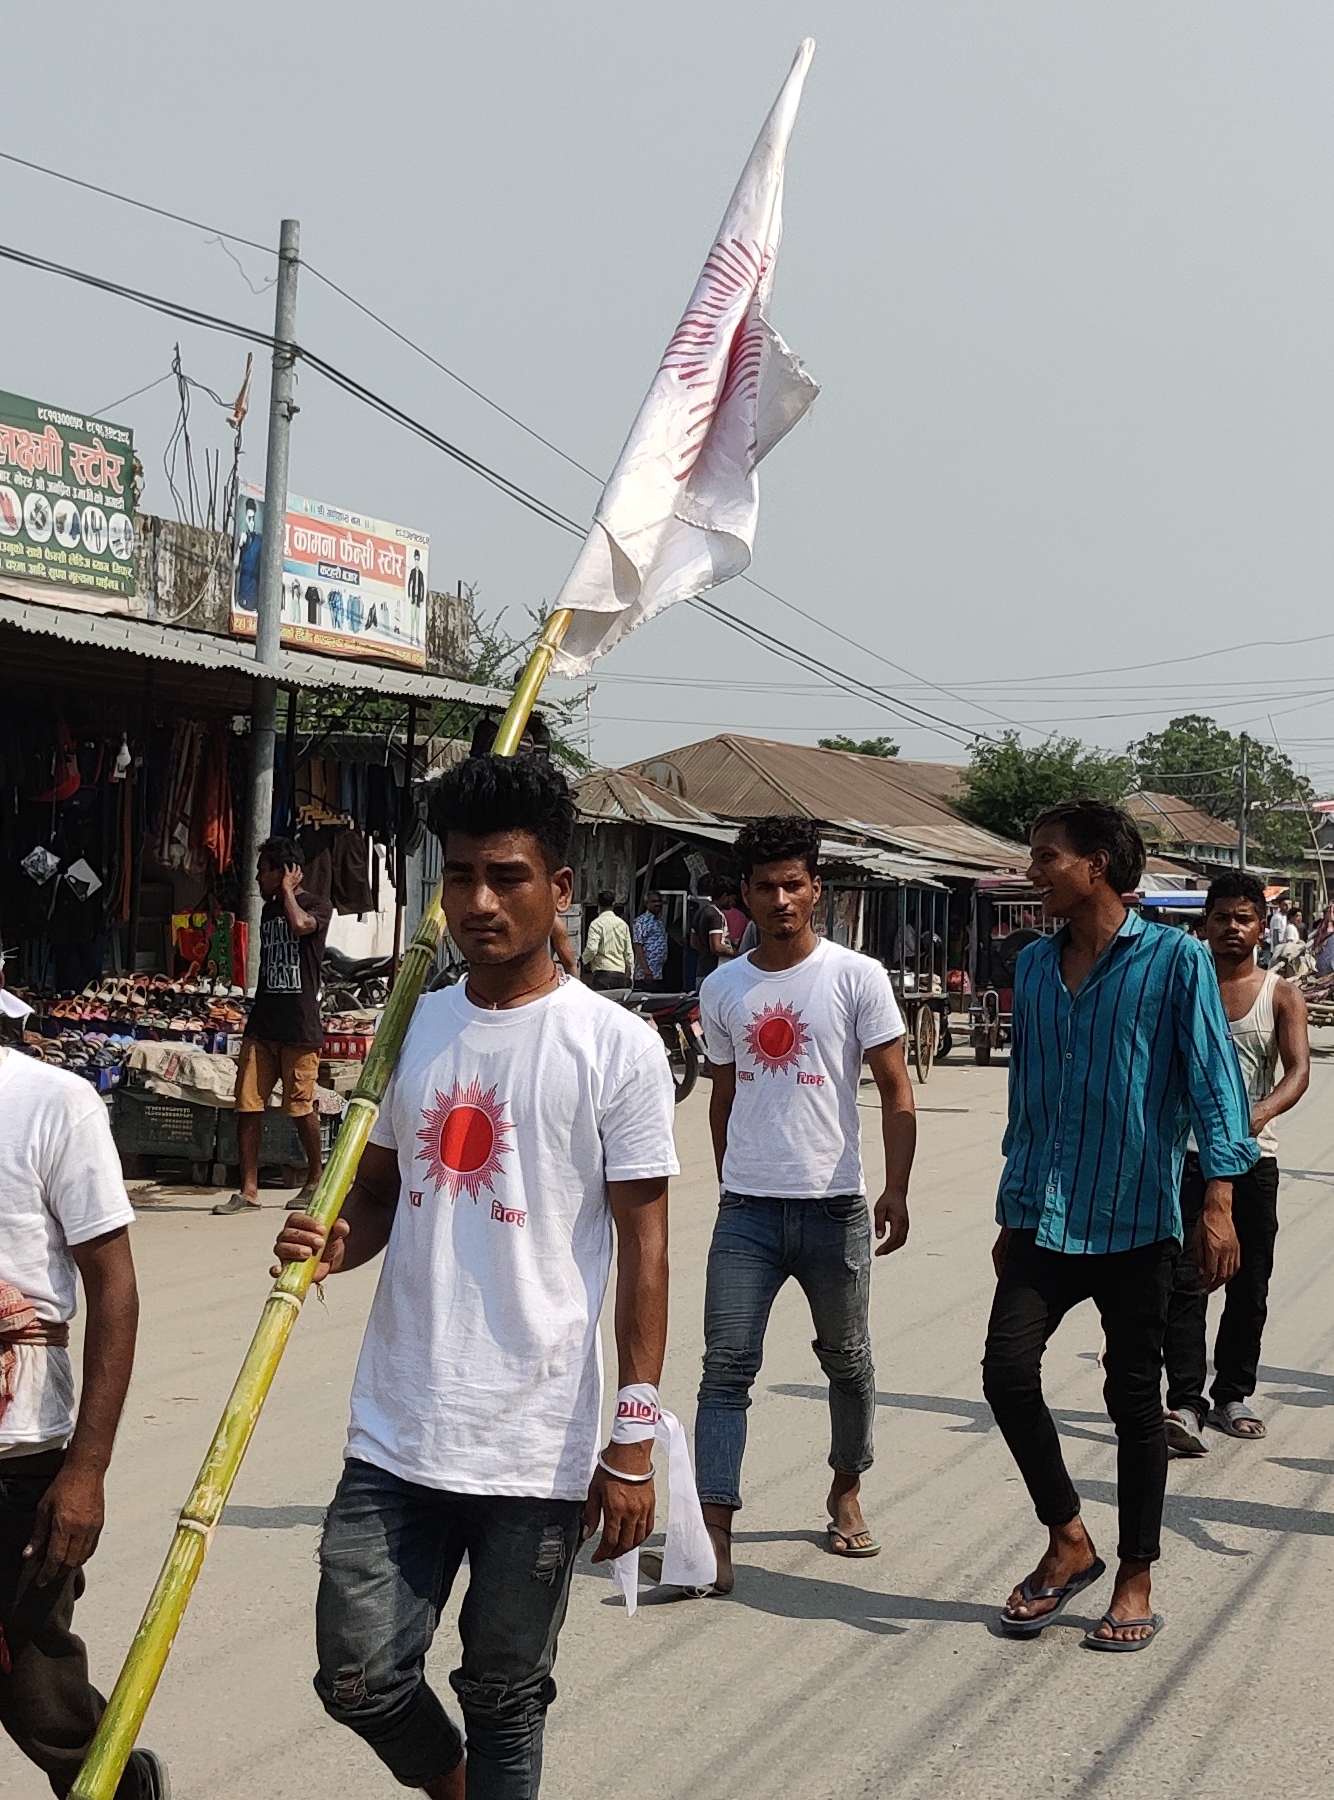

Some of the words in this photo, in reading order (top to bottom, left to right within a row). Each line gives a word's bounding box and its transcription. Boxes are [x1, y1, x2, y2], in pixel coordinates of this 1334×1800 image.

[69, 437, 125, 494] स्टोर
[293, 525, 336, 560] कामना
[377, 544, 405, 579] स्टोर
[797, 1072, 825, 1087] चिन्ह
[491, 1199, 527, 1228] चिन्ह
